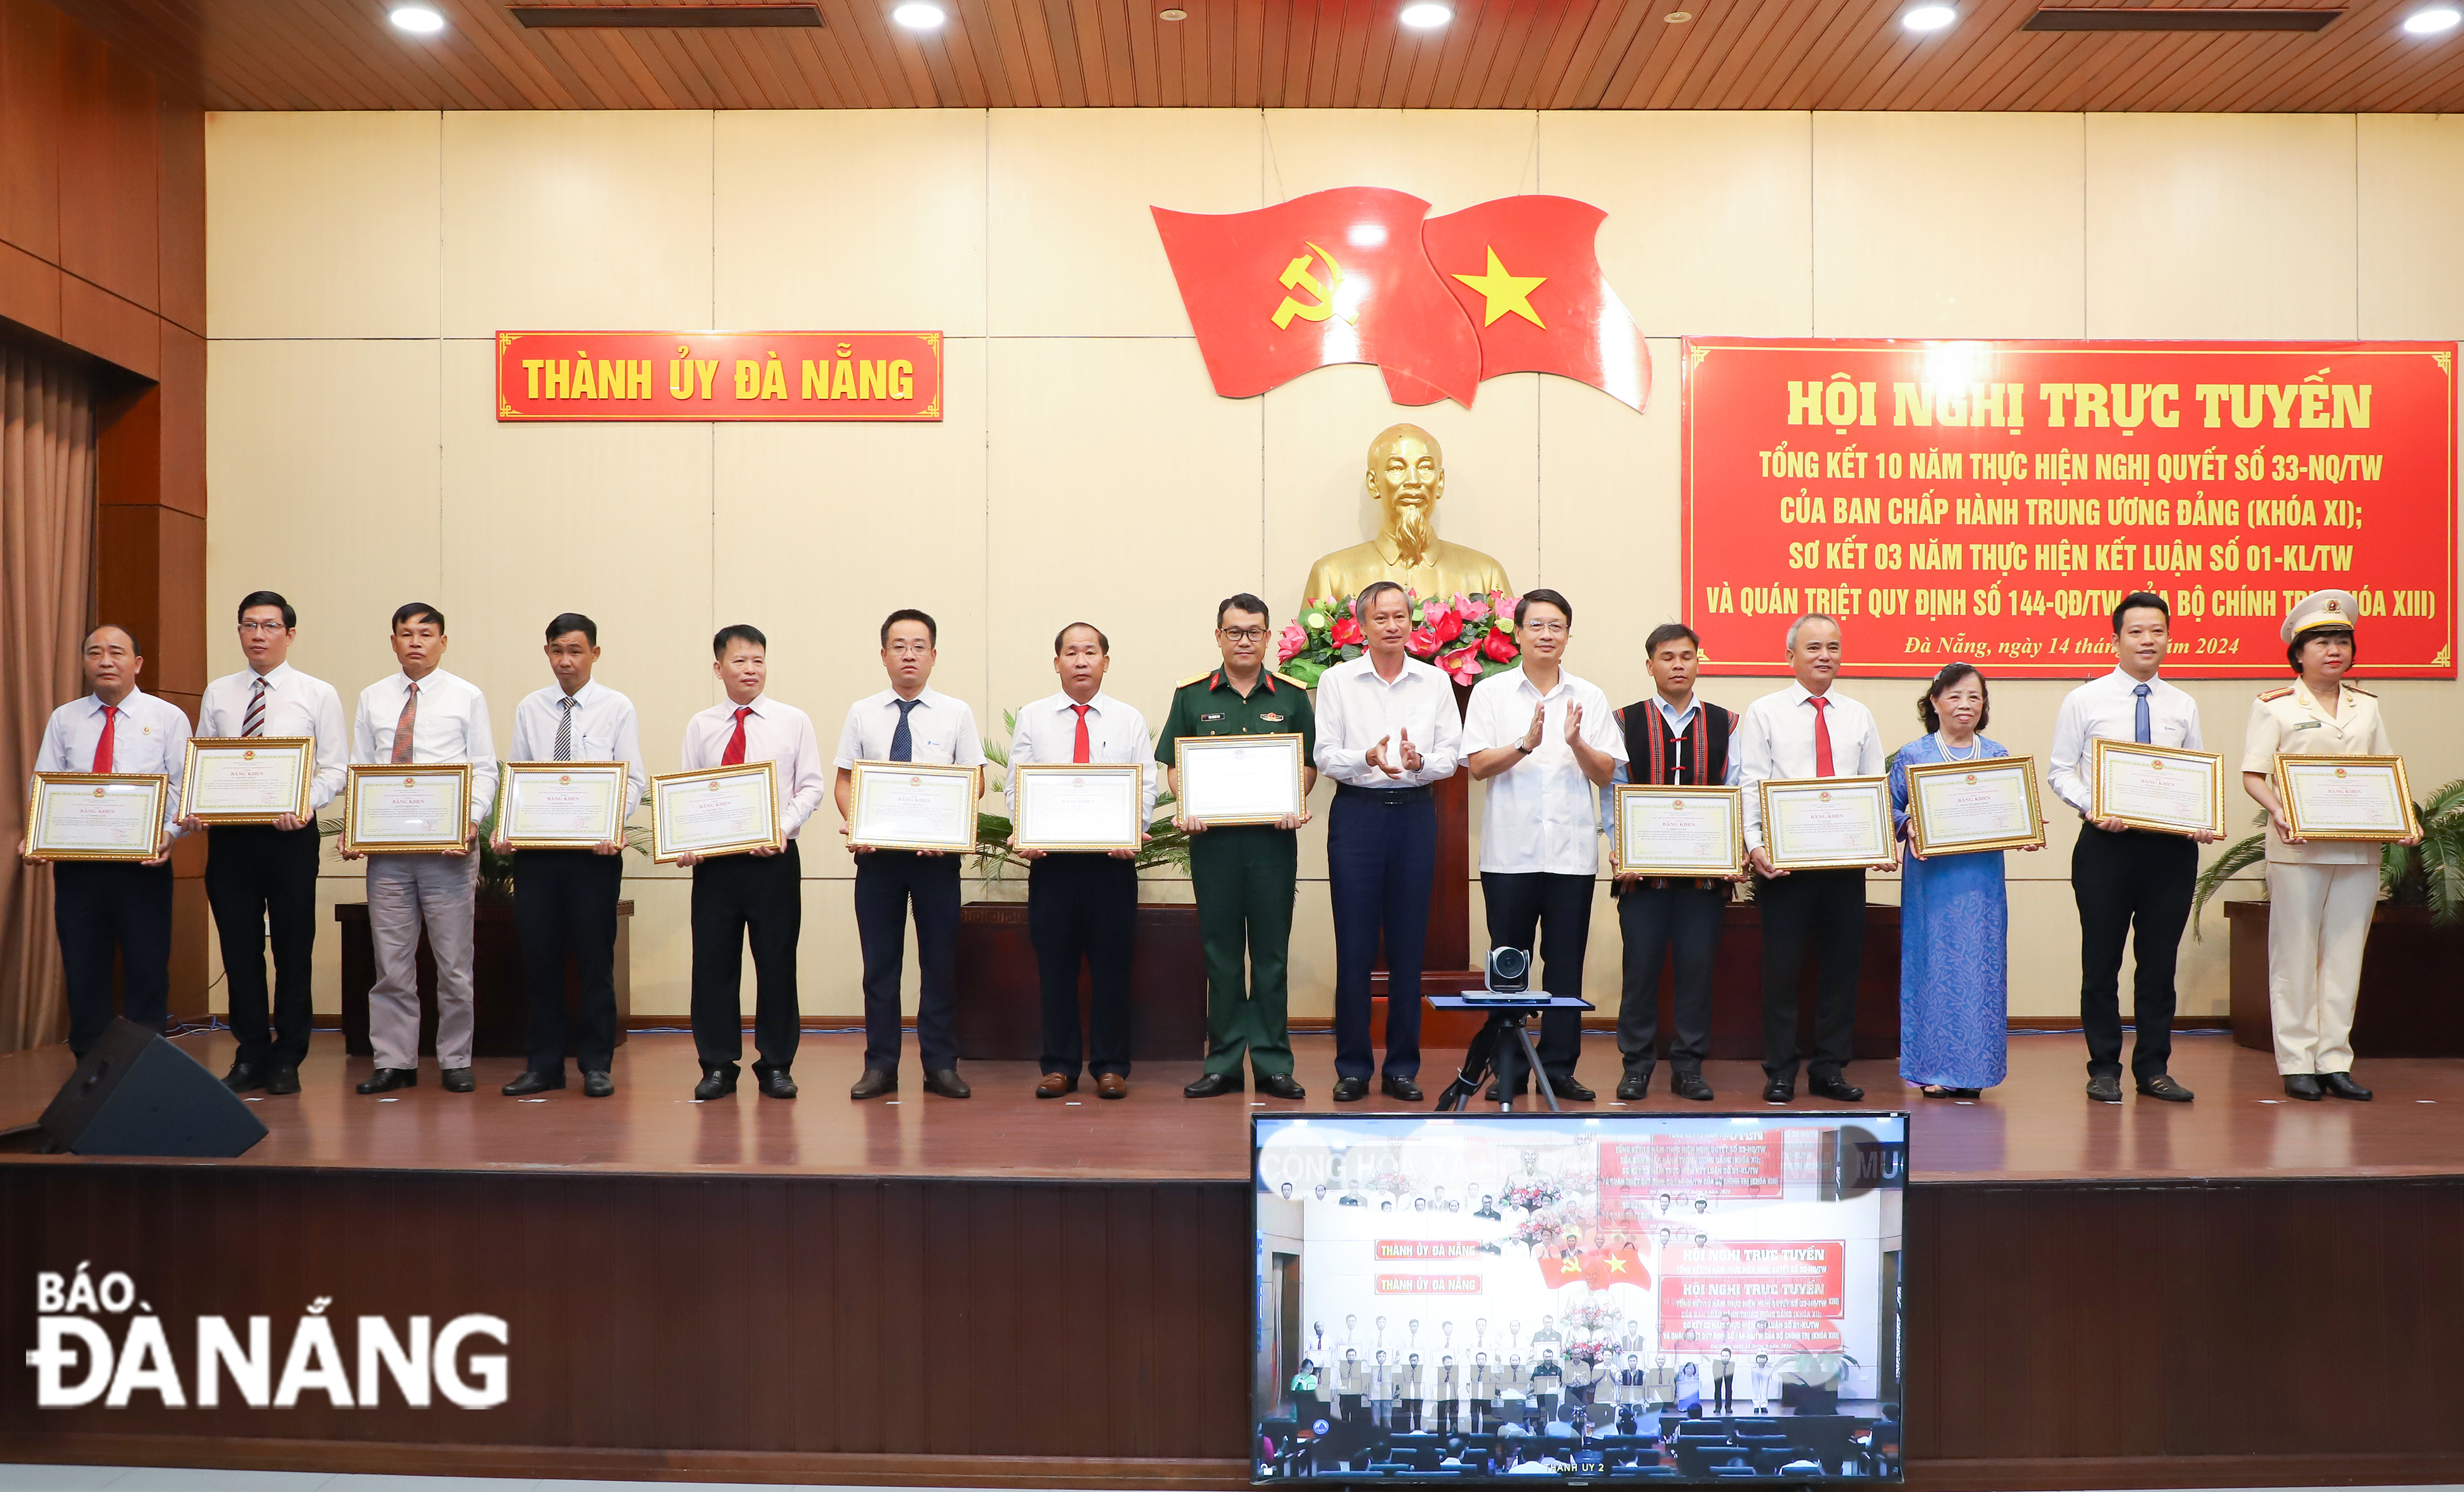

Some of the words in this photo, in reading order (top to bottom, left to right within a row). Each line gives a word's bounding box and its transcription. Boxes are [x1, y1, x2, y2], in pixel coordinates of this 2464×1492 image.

[522, 351, 652, 400] THÀNH
[669, 345, 720, 400] ỦY
[734, 351, 788, 400] ĐÀ
[801, 342, 913, 400] NẴNG
[1787, 372, 1877, 435] HỘI
[1893, 382, 2025, 435] NGHỊ
[2039, 382, 2180, 436] TRỰC
[2195, 366, 2373, 429] TUYẾN
[1758, 440, 1819, 480] TỔNG
[1826, 443, 1868, 480] KẾT
[1875, 452, 1903, 480] 10
[1909, 447, 1963, 480] NĂM
[1969, 450, 2028, 486] THỰC
[2035, 447, 2089, 486] HIỆN
[2095, 453, 2150, 487] NGHỊ
[2157, 444, 2228, 484] QUYẾT
[2234, 445, 2265, 481] SỐ
[2272, 454, 2383, 484] 33-NQ/TW
[1780, 487, 1826, 525] CỦA
[1833, 497, 1880, 524] BAN
[1888, 488, 1949, 525] CHẤP
[1956, 492, 2019, 525] HÀNH
[2025, 499, 2100, 526] TRUNG
[2108, 496, 2170, 526] ƯƠNG
[2176, 491, 2239, 527] ĐẢNG
[2247, 494, 2317, 529] (KHÓA
[2323, 500, 2362, 530] XI);
[1788, 539, 1820, 569] SƠ
[1826, 534, 1868, 570] KẾT
[1874, 543, 1902, 570] 03
[1909, 537, 1962, 570] NĂM
[1969, 541, 2028, 577] THỰC
[2035, 538, 2088, 577] HIỆN
[2095, 535, 2137, 571] KẾT
[2143, 539, 2202, 577] LUẬN
[2209, 535, 2240, 572] SỐ
[2246, 544, 2354, 572] 01-KL/TW
[1706, 581, 1734, 614] VÀ
[1740, 581, 1798, 617] QUÁN
[1804, 582, 1862, 621] TRIỆT
[1868, 588, 1910, 619] QUY
[1915, 589, 1967, 622] ĐỊNH
[1972, 579, 2002, 616] SỐ
[2008, 589, 2122, 619] 144-QĐ/TW
[2177, 584, 2206, 622] BỘ
[2212, 584, 2276, 617] CHÍNH
[2392, 590, 2435, 620] XIII)
[1903, 636, 1931, 654] Đà
[1936, 632, 1992, 659] Nẵng,
[1997, 637, 2043, 659] ngày
[2047, 637, 2070, 654] 14
[2194, 637, 2240, 654] 2024
[1381, 1243, 1413, 1256] THÀNH
[1431, 1243, 1445, 1256] ĐÀ
[1781, 1245, 1825, 1261] TUYẾN
[1381, 1277, 1413, 1291] THÀNH
[1431, 1277, 1445, 1291] ĐÀ
[1544, 1463, 1577, 1472] THANH
[1582, 1463, 1595, 1472] UY
[1598, 1463, 1604, 1472] 2
